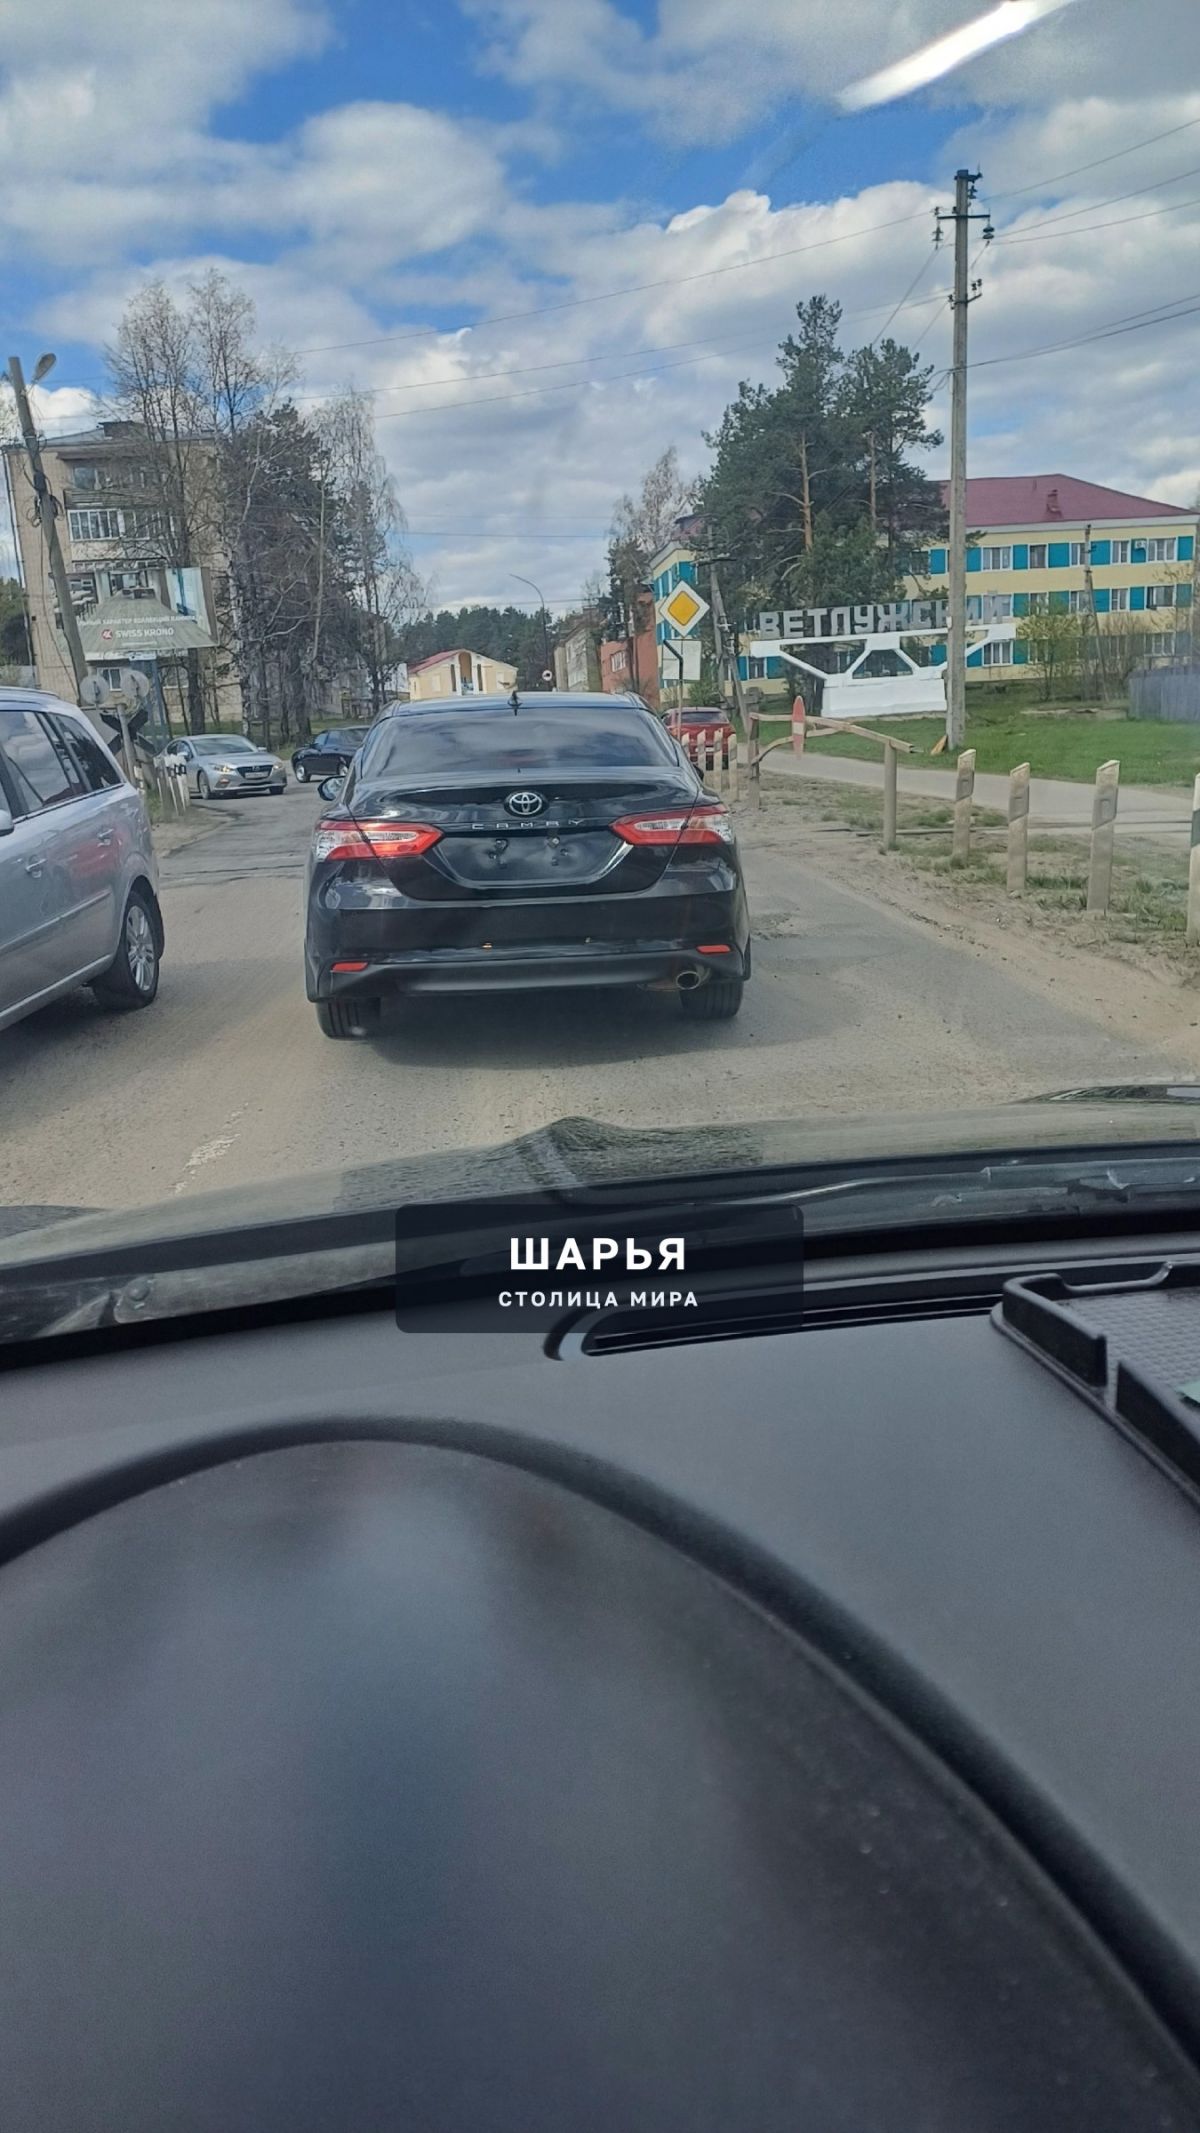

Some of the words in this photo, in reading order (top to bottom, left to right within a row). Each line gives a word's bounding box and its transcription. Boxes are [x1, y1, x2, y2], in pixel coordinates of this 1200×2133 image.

[114, 629, 143, 638] SWISS
[144, 627, 175, 637] KRONO
[472, 818, 585, 830] CAMRY
